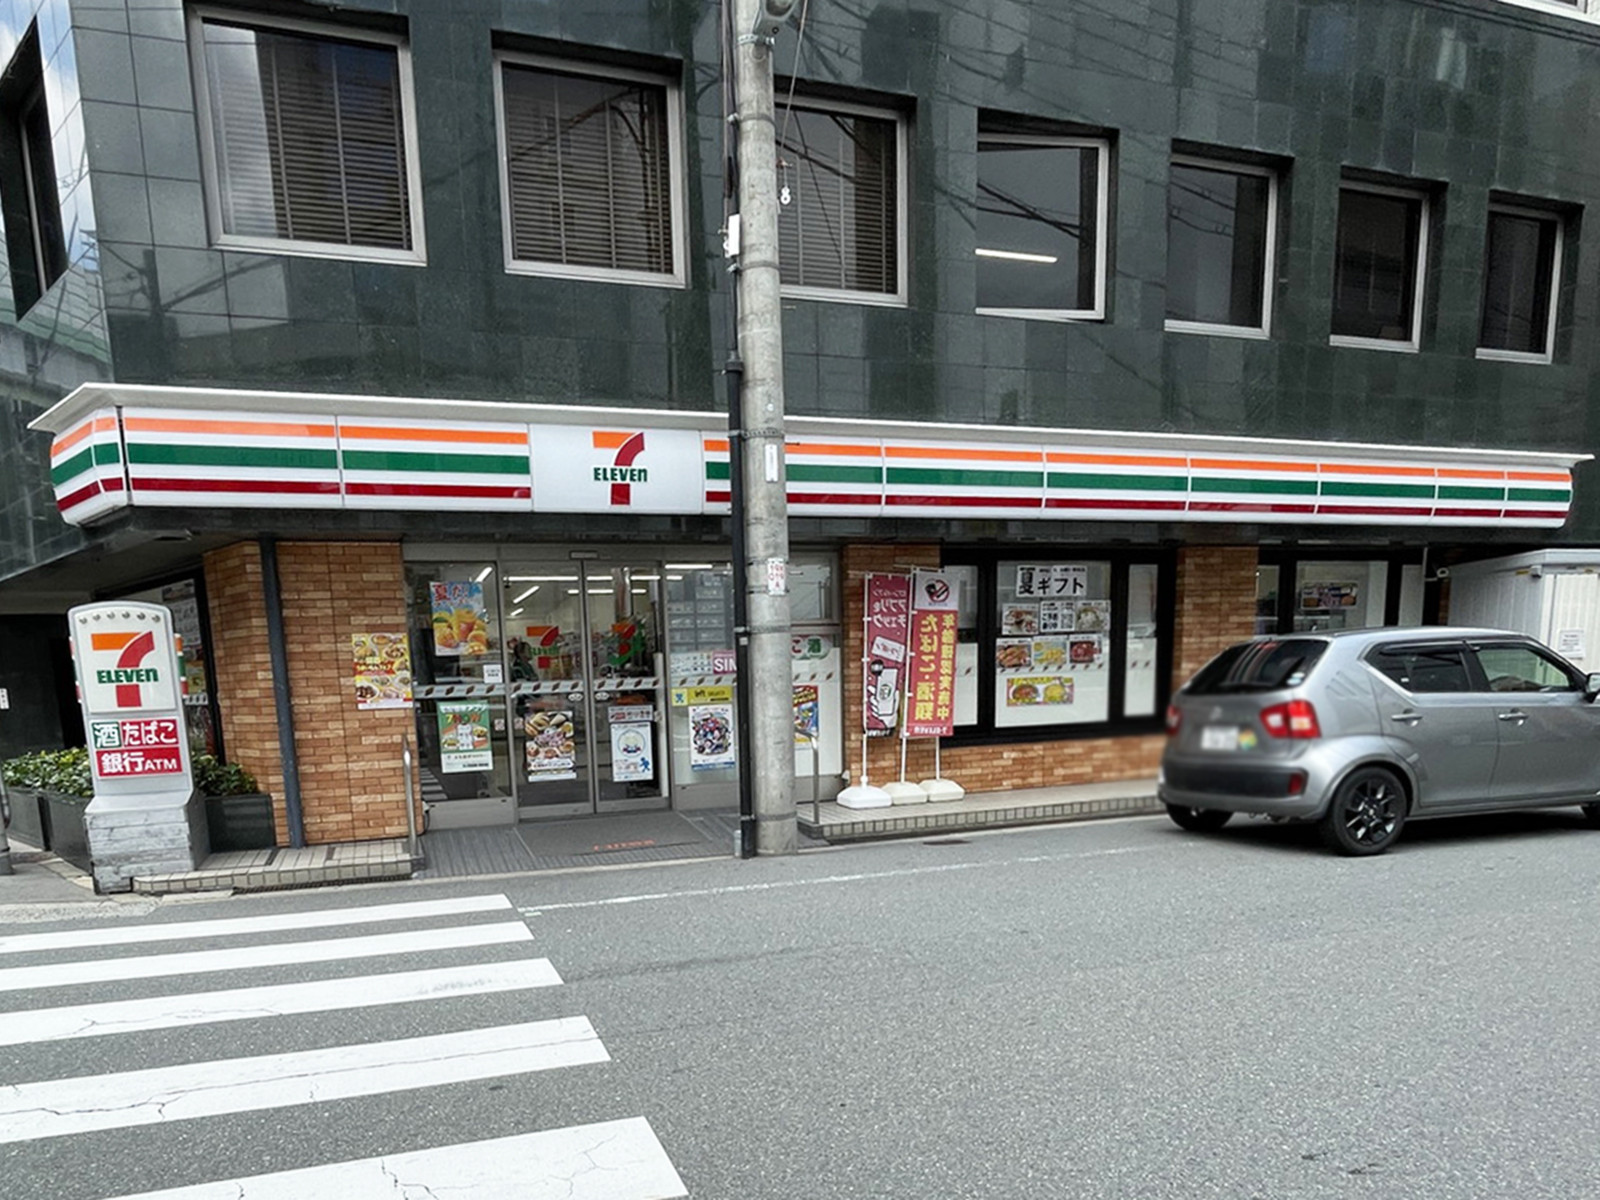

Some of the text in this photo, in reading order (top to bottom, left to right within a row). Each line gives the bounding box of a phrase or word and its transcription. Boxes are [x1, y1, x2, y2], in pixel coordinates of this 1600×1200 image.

[1019, 567, 1083, 595] 夏ギフト
[95, 723, 121, 748] 酒
[123, 722, 177, 746] たばこ
